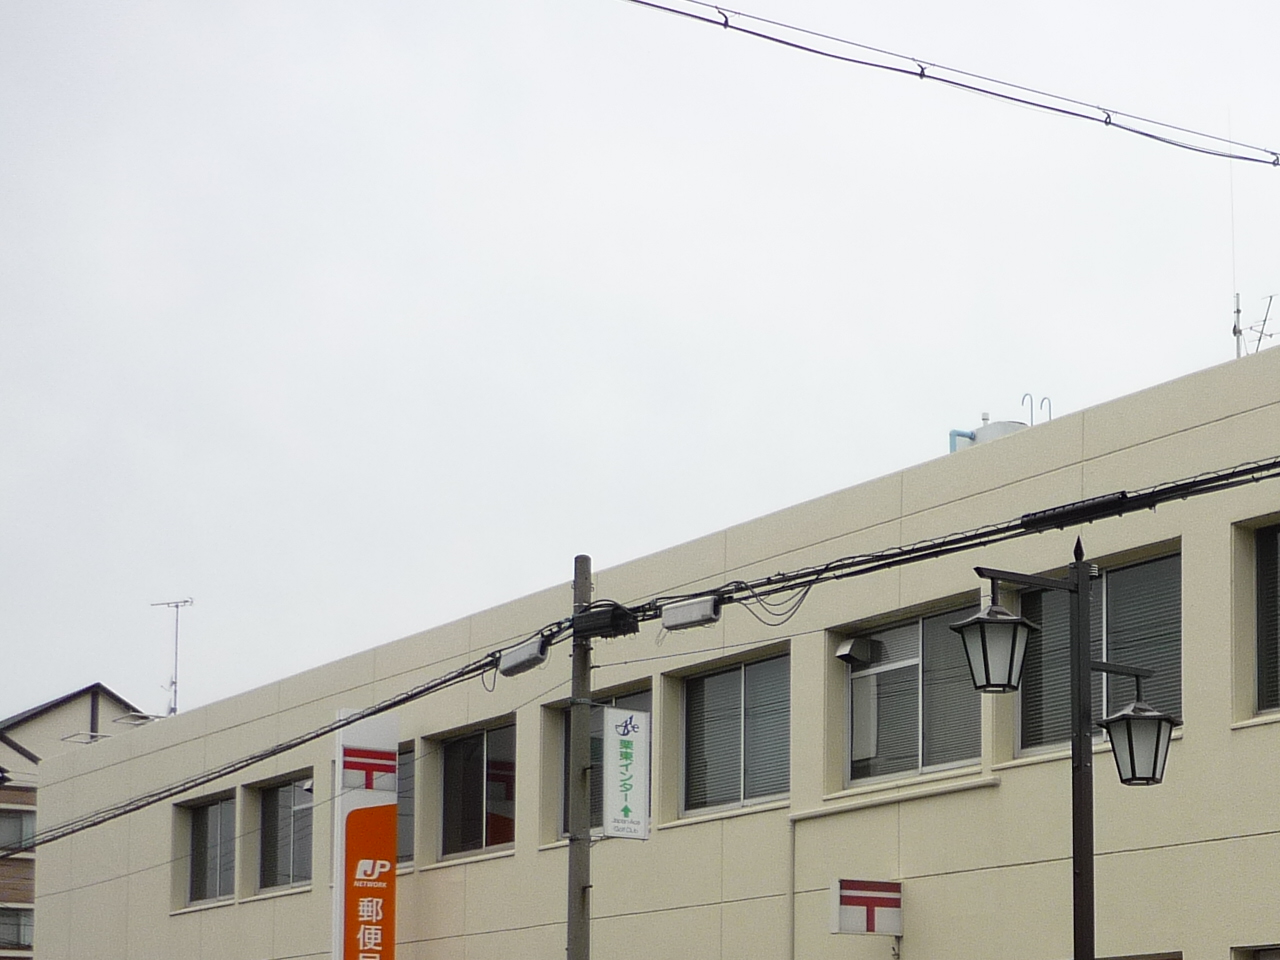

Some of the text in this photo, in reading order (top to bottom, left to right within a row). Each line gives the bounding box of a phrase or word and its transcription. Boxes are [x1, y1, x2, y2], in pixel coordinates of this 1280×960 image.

[619, 739, 634, 802] 栗東インター
[355, 859, 391, 880] JP
